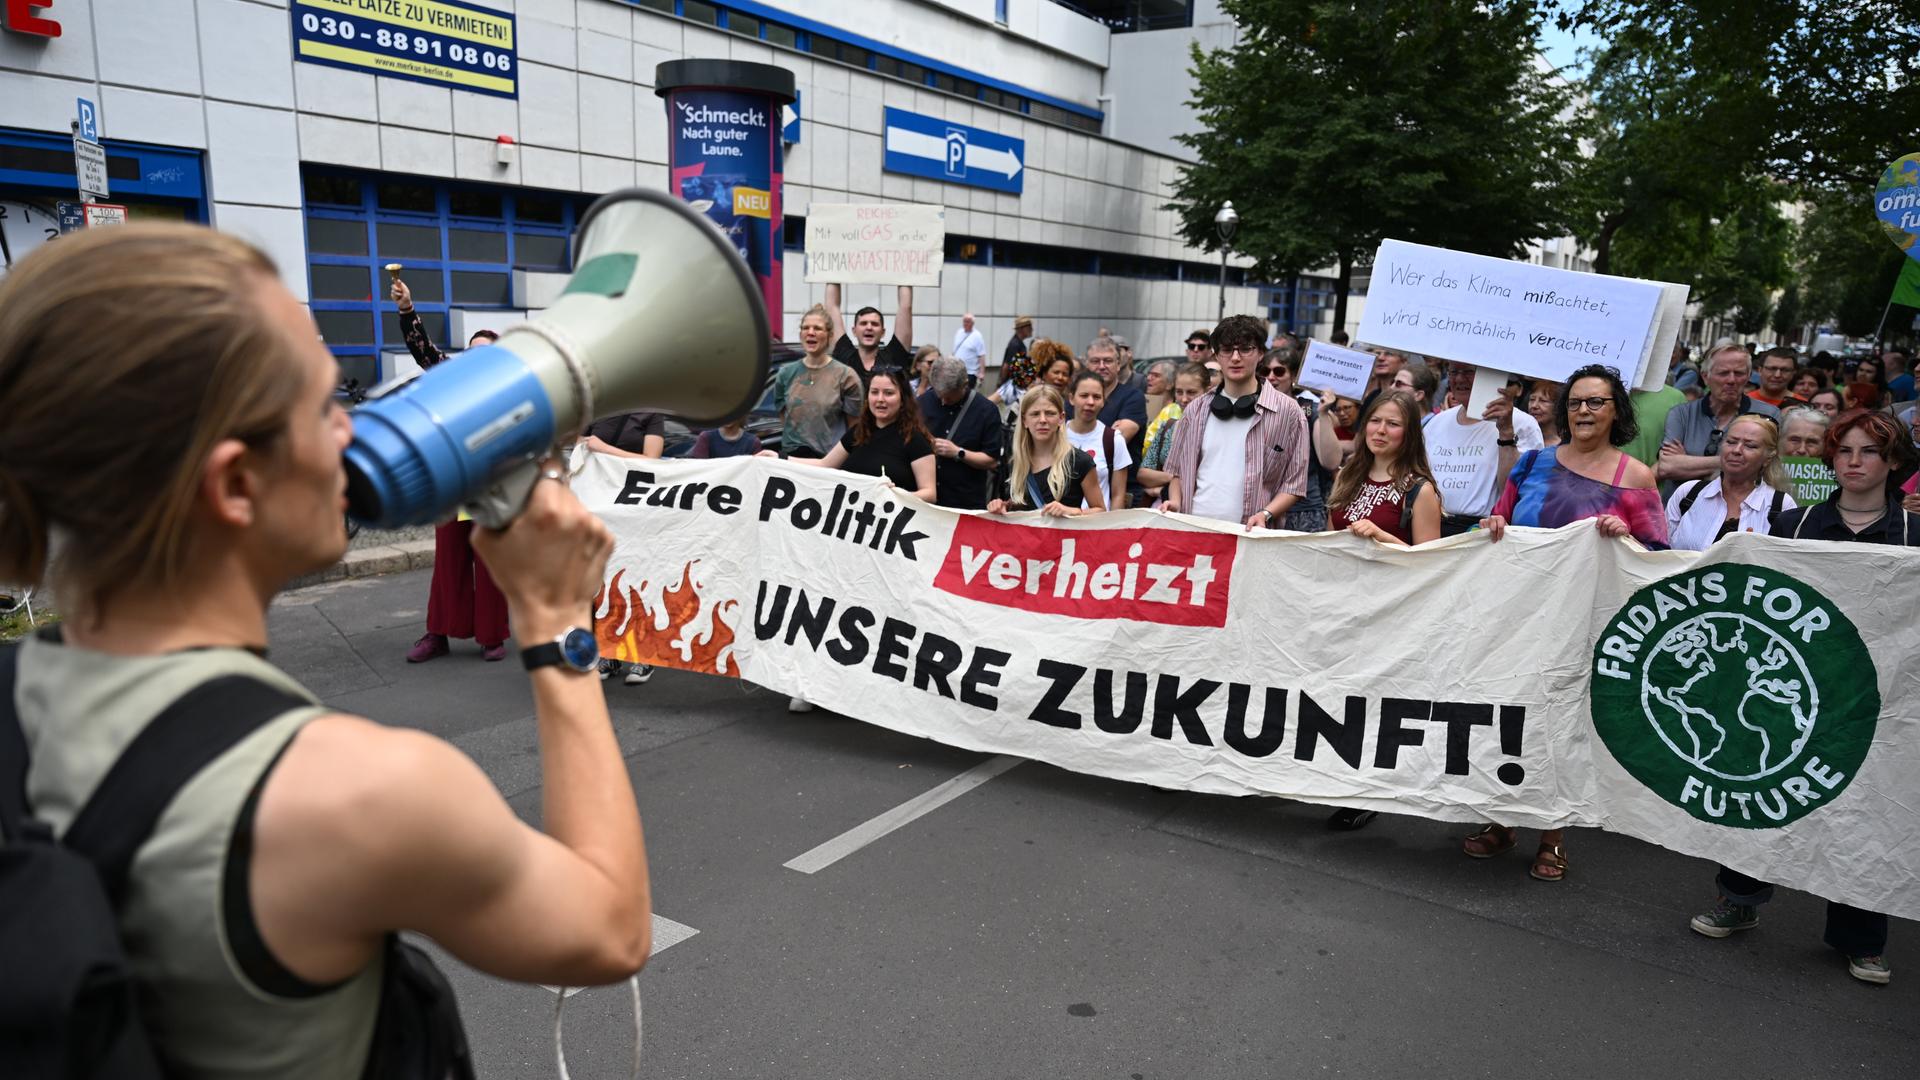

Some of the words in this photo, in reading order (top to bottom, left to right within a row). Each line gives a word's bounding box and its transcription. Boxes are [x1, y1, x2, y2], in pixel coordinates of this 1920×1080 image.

[405, 3, 424, 22] ZU
[427, 8, 508, 41] VERMIETEN!
[302, 13, 355, 40] 030
[376, 29, 409, 50] 88
[413, 36, 442, 57] 91
[449, 44, 478, 64] 08
[482, 51, 511, 71] 06
[374, 57, 454, 79] www.merkur-berlin.de
[81, 103, 92, 136] P
[685, 104, 767, 128] Schmeckt.
[682, 127, 712, 140] Nach
[714, 128, 749, 143] guter
[702, 142, 743, 157] Laune.
[949, 141, 963, 173] P
[100, 208, 116, 218] 100
[737, 195, 769, 211] NEU
[815, 226, 832, 240] Mit
[898, 231, 910, 241] in
[912, 230, 928, 242] die
[812, 250, 933, 274] KLIMAKATASTROPHE
[1390, 262, 1426, 286] Wer
[1431, 269, 1459, 289] das
[1467, 273, 1512, 298] Klima
[1523, 290, 1611, 318] mißachtet,
[1382, 309, 1421, 327] wird
[1528, 332, 1608, 357] verachtet
[1315, 353, 1336, 363] Reiche
[1337, 359, 1363, 371] zerstört
[1311, 367, 1332, 378] unsere
[1333, 373, 1359, 385] Zukunft
[1457, 445, 1485, 457] WIR
[1432, 461, 1476, 473] erbannt
[1442, 477, 1470, 489] Gier
[614, 470, 743, 515] Eure
[759, 476, 930, 561] Politik
[960, 538, 1217, 607] verheizt
[1597, 572, 1727, 680] FRIDAYS
[1743, 576, 1831, 643] FOR
[754, 580, 1012, 712] UNSERE
[1027, 658, 1526, 786] ZUKUNFT!
[1679, 756, 1845, 821] FUTURE
